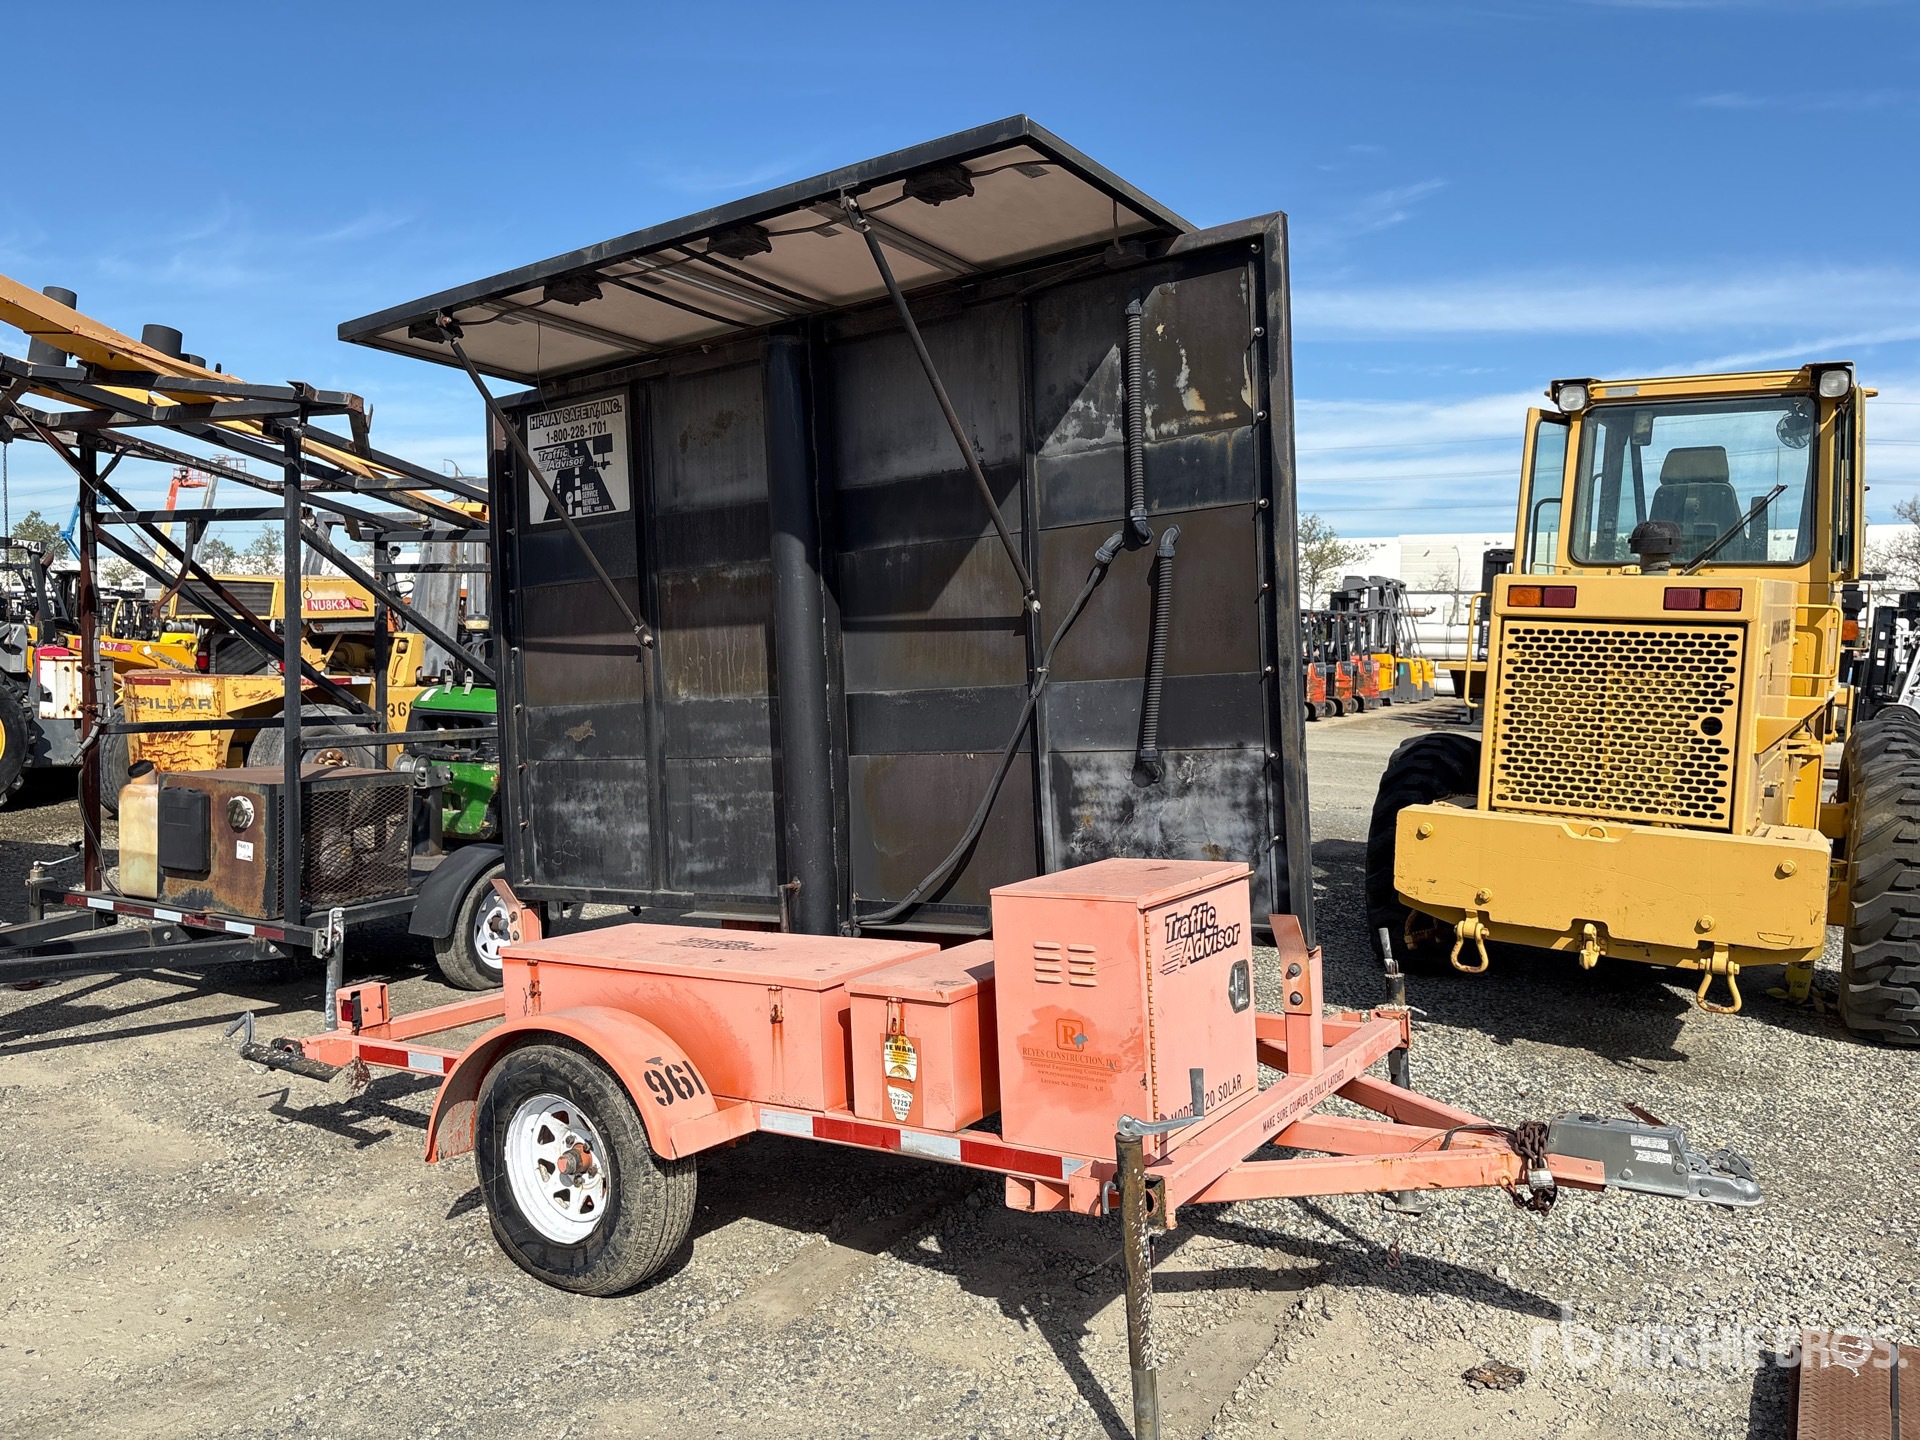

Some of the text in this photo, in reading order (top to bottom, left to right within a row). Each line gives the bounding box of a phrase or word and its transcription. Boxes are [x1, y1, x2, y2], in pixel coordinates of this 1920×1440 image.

[530, 398, 622, 430] HI-WAY SAFETY, INC.
[546, 420, 607, 444] 1-800-228-1701
[538, 447, 569, 463] Traffic
[547, 455, 585, 472] Advisor
[311, 599, 350, 611] NU8K34
[387, 701, 413, 719] 36
[1165, 901, 1217, 944] Traffic
[1180, 923, 1241, 969] Advisor
[1022, 1047, 1045, 1058] REYES
[1045, 1050, 1105, 1067] CONSTRUCTION,
[1030, 1061, 1113, 1078] General Engineering Contractor
[643, 1060, 706, 1107] 961
[1040, 1077, 1061, 1086] License
[1217, 1073, 1242, 1102] SOLAR
[1262, 1068, 1345, 1133] MAKE SURE COUPLER IS FULLY LATCHED
